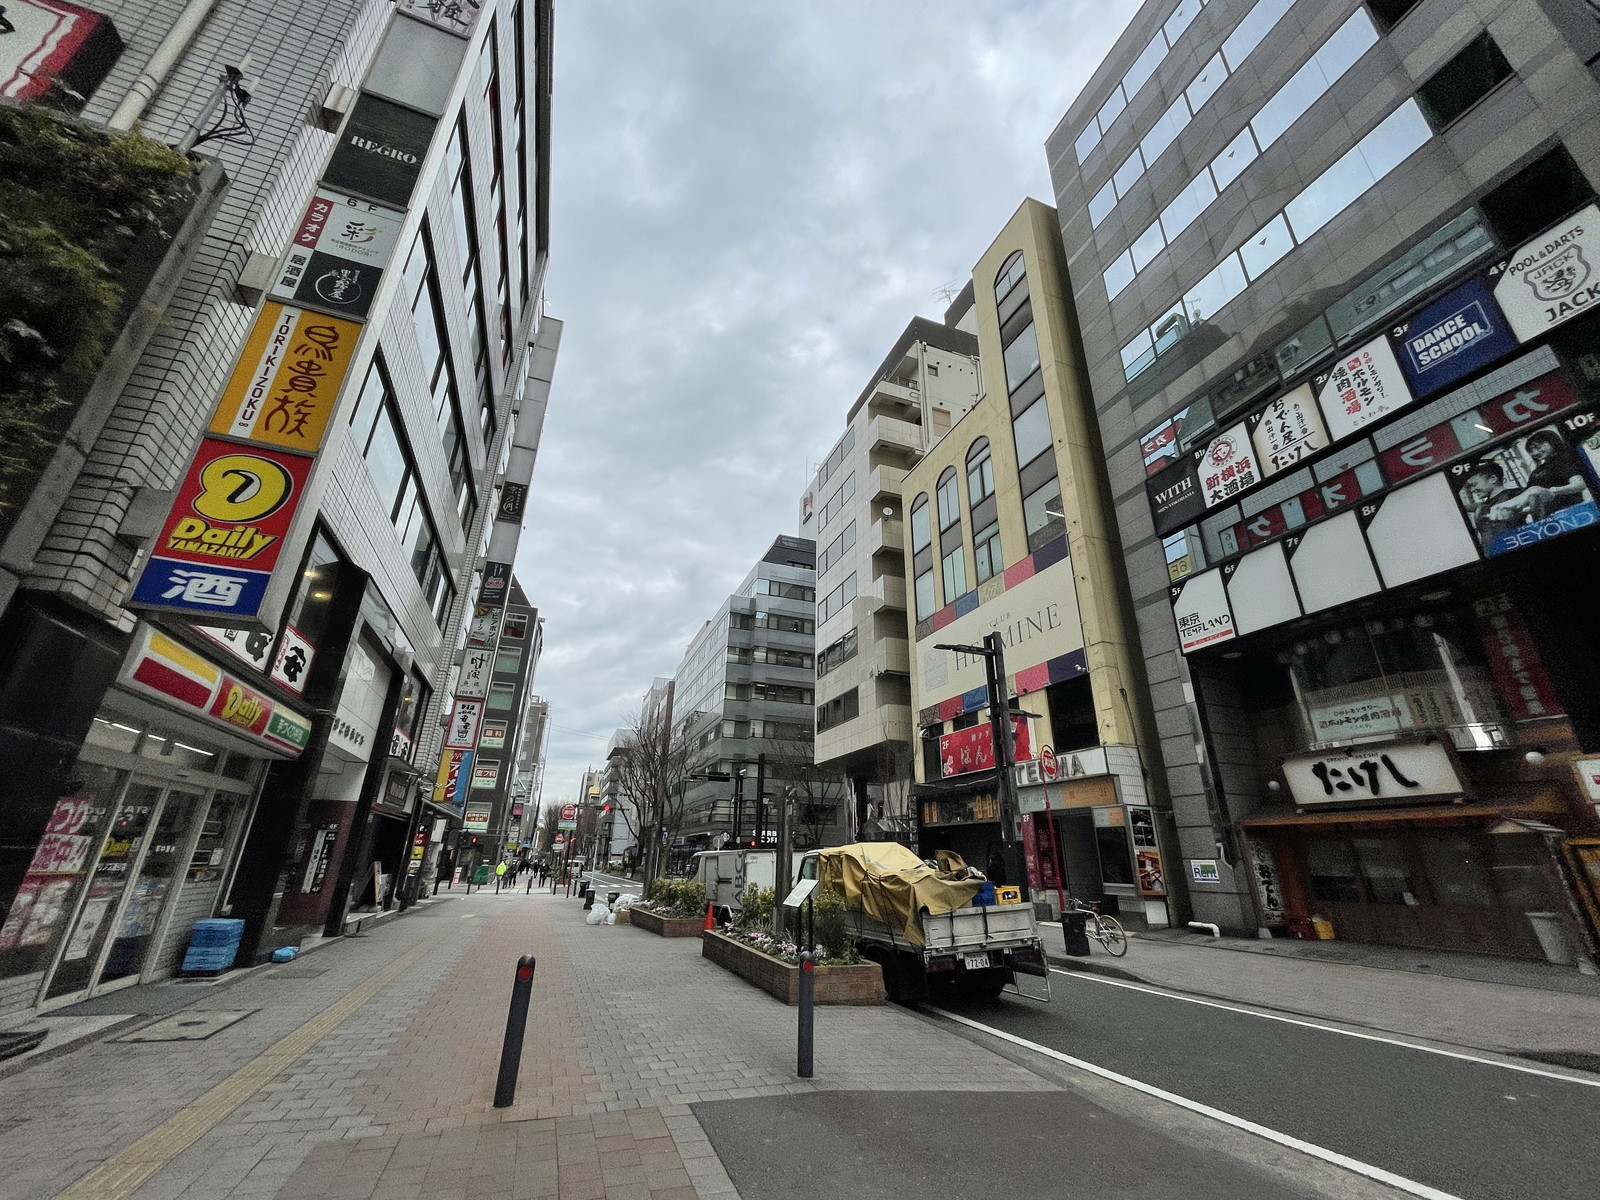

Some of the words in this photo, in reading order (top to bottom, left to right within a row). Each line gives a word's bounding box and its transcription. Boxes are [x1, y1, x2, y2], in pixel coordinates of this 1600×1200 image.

[301, 203, 328, 242] カラオケ
[341, 221, 378, 244] 彩
[280, 254, 307, 289] 居酒屋
[1488, 260, 1508, 276] 4F
[1534, 253, 1575, 280] JACK
[1547, 281, 1600, 322] JACK
[1393, 324, 1409, 337] 3F
[1412, 314, 1467, 352] DANCE
[1419, 325, 1484, 366] SCHOOL
[242, 314, 295, 421] TORIKIZOKU
[264, 325, 340, 438] 鳥貴族
[1315, 373, 1329, 385] 2F
[1332, 366, 1362, 416] 焼肉酒場
[1351, 369, 1375, 407] ホルモン
[1250, 413, 1261, 424] 1F
[1271, 399, 1297, 446] おでん屋
[1565, 412, 1596, 430] 10F
[1271, 441, 1318, 471] たけし
[1451, 462, 1471, 476] 9F
[1205, 456, 1251, 491] 新横浜
[1210, 470, 1256, 504] 大酒場
[1155, 476, 1193, 505] WITH
[1362, 505, 1378, 517] 8F
[170, 516, 280, 560] Daily
[1286, 538, 1298, 548] 7F
[1503, 511, 1594, 550] BEYOND
[168, 538, 244, 559] YAMAZAKI
[1224, 565, 1235, 574] 6F
[161, 569, 249, 607] 酒
[1171, 587, 1181, 596] 5F
[1178, 612, 1200, 629] 東京
[942, 740, 950, 750] 2F
[1311, 754, 1419, 797] たけし
[1194, 867, 1218, 878] Rent
